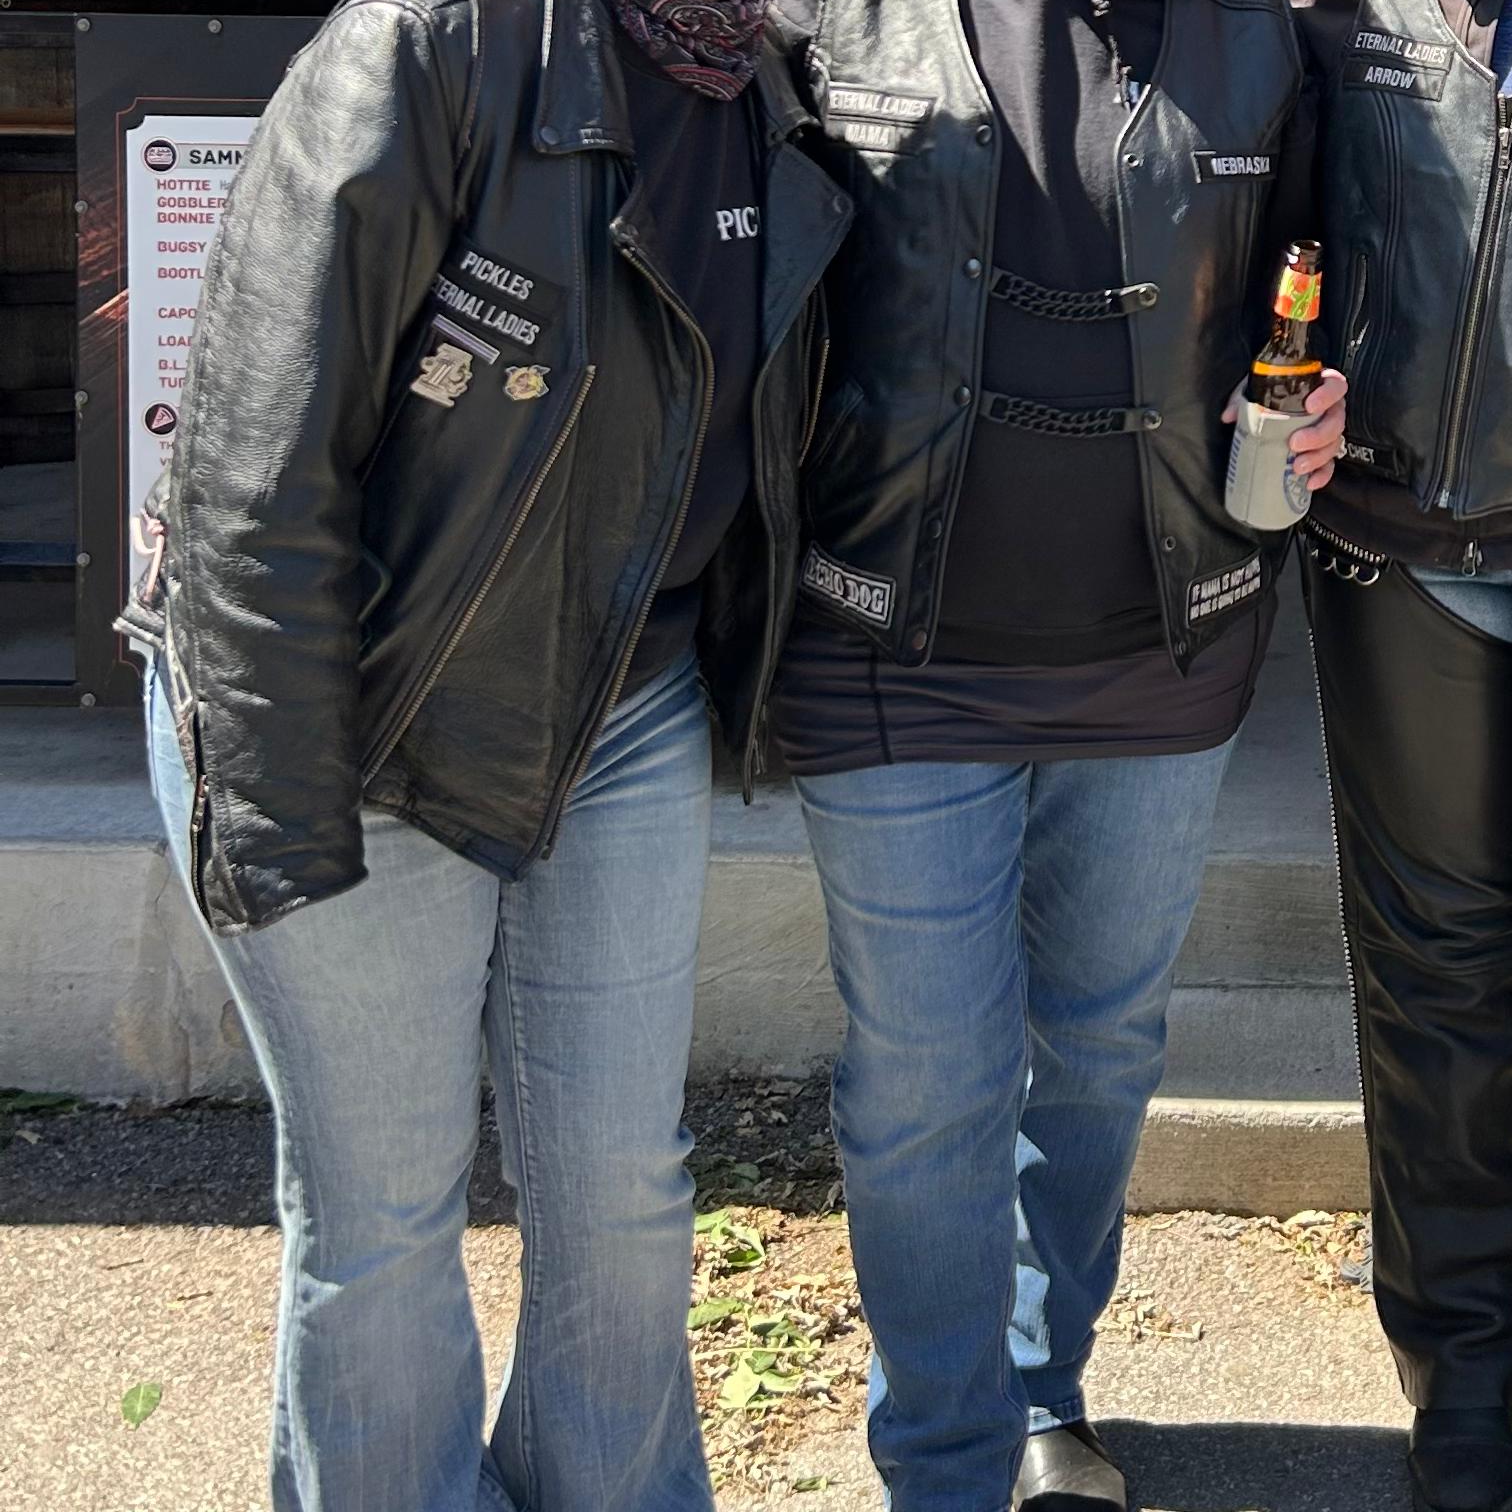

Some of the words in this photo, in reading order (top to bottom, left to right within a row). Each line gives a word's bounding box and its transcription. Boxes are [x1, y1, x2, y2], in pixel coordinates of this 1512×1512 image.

[1355, 32, 1403, 55] ETERNAL
[1403, 42, 1448, 64] LADIES
[1364, 66, 1416, 88] ARROW
[157, 179, 211, 191] HOTTIE
[157, 213, 215, 224] BONNIE
[716, 206, 760, 241] PIC
[157, 241, 207, 253] BUGSY
[460, 250, 535, 301] PICKLES
[433, 273, 486, 320] TERNAL
[482, 305, 541, 345] LADIES
[845, 579, 884, 613] DOG
